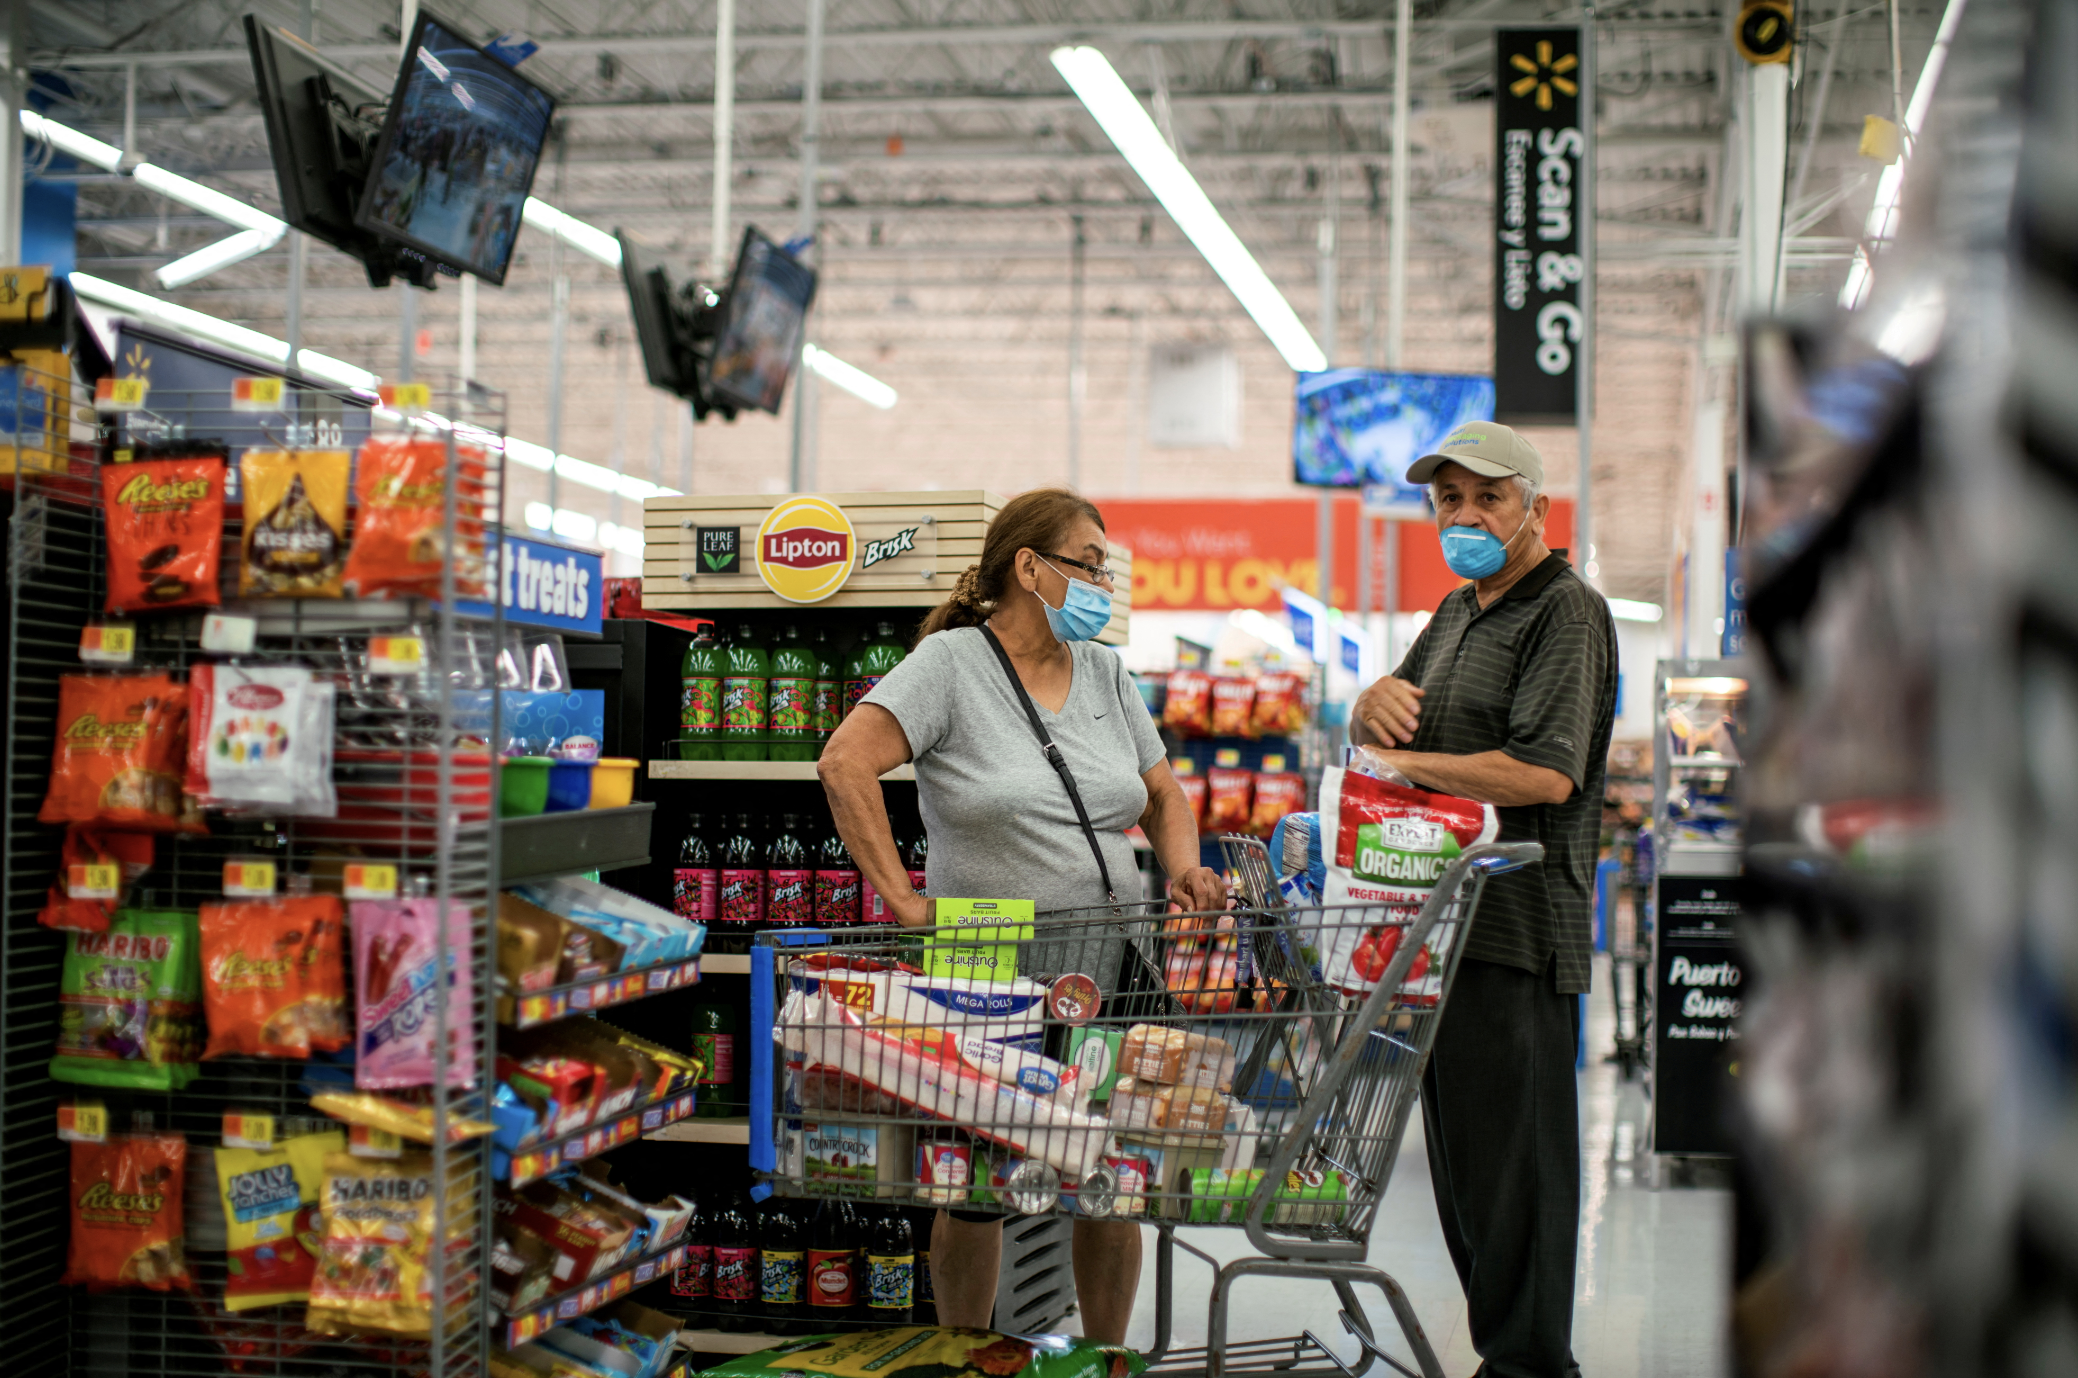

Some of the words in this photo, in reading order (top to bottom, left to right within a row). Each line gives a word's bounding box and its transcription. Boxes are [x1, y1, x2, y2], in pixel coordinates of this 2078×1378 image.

[1537, 127, 1584, 241] Scan
[1505, 250, 1532, 310] Listo
[1537, 251, 1584, 292] &
[1536, 301, 1584, 375] Go
[118, 474, 209, 504] Reese's
[703, 531, 734, 542] PURE
[703, 541, 734, 552] LEAF
[770, 537, 841, 562] Lipton
[863, 528, 917, 568] Brisk
[518, 545, 590, 620] treats
[64, 714, 149, 740] Reese's
[774, 880, 802, 902] Brisk
[1347, 886, 1405, 902] VEGETABLE
[1409, 893, 1417, 902] &
[957, 915, 1014, 929] Outshine
[73, 932, 171, 962] HARIBO
[944, 954, 999, 969] Outshine
[1668, 955, 1741, 987] Puerto
[845, 985, 872, 1006] 72
[956, 994, 984, 1009] MEGA
[988, 997, 1013, 1009] ROLLS
[229, 1166, 289, 1198] JOLLY
[331, 1176, 431, 1202] HARIBO
[79, 1183, 163, 1212] Reese's
[232, 1184, 297, 1209] rancher
[717, 1259, 744, 1279] Brisk
